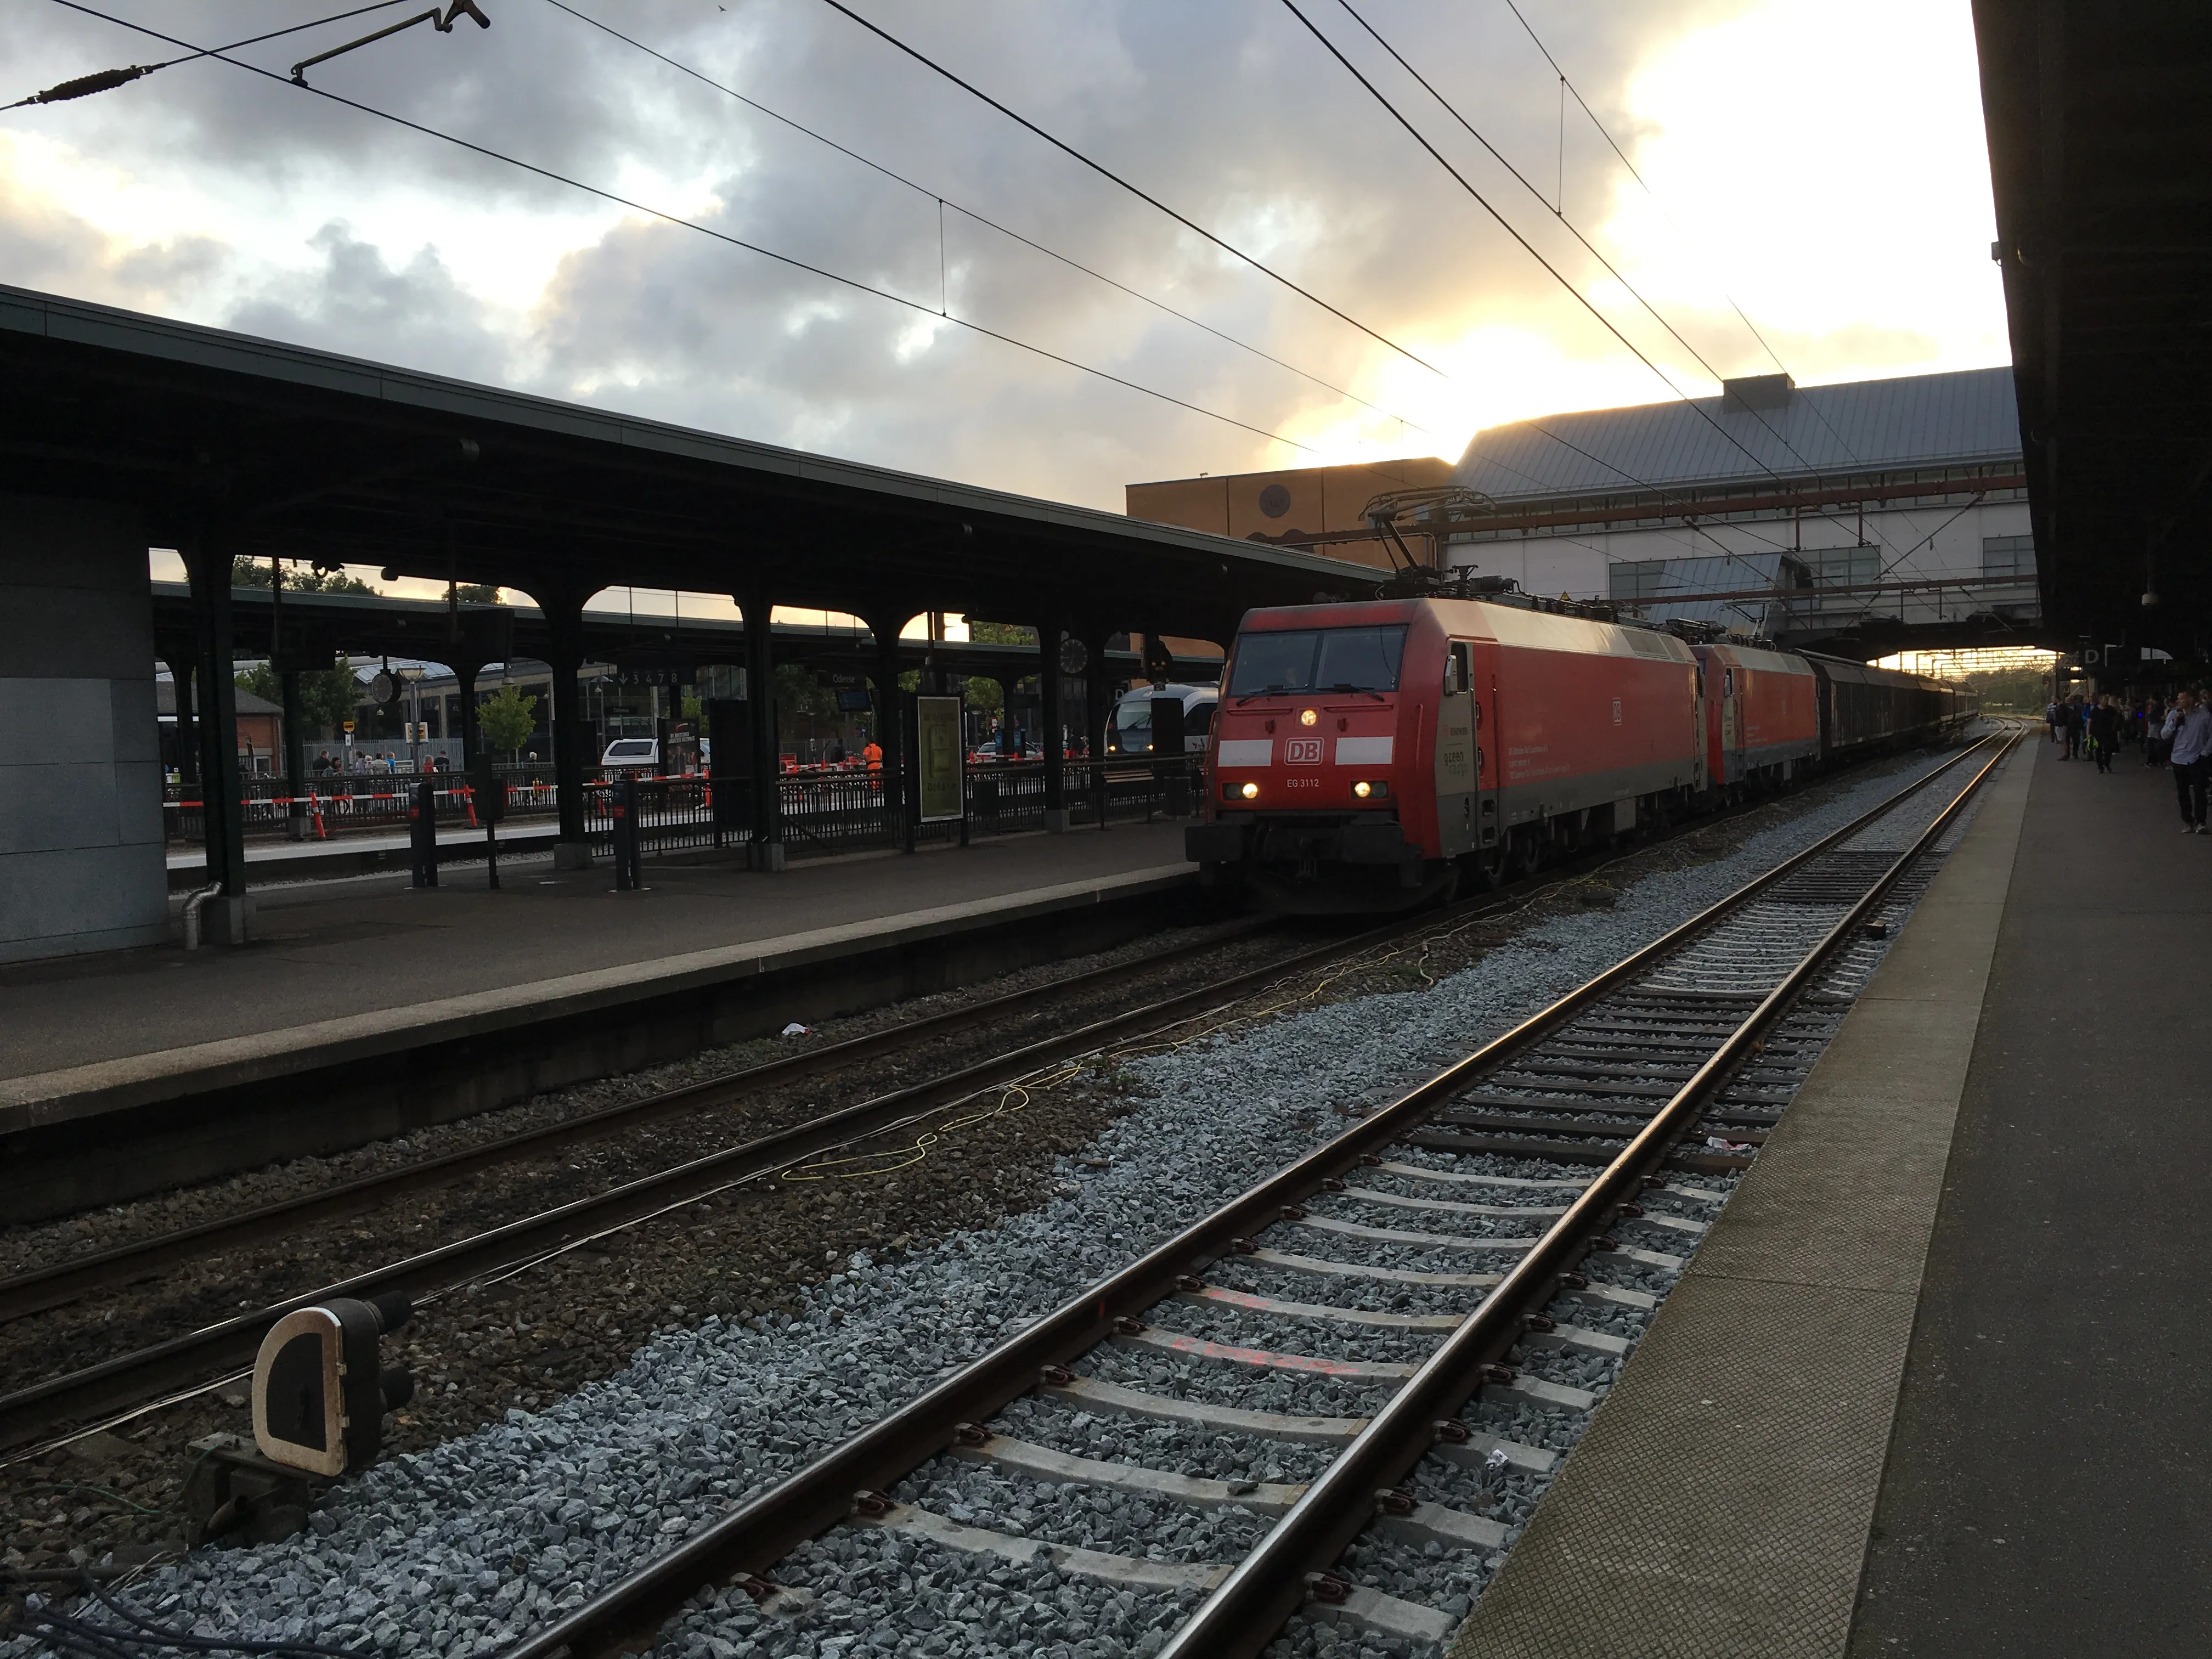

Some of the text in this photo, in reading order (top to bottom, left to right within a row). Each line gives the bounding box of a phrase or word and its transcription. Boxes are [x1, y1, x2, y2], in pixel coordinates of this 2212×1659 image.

[2085, 649, 2100, 664] D
[634, 673, 678, 684] 3 4 7 8
[833, 674, 855, 683] Odense
[1290, 742, 1318, 760] DB
[1444, 751, 1464, 766] green
[1286, 778, 1319, 787] EG 3112
